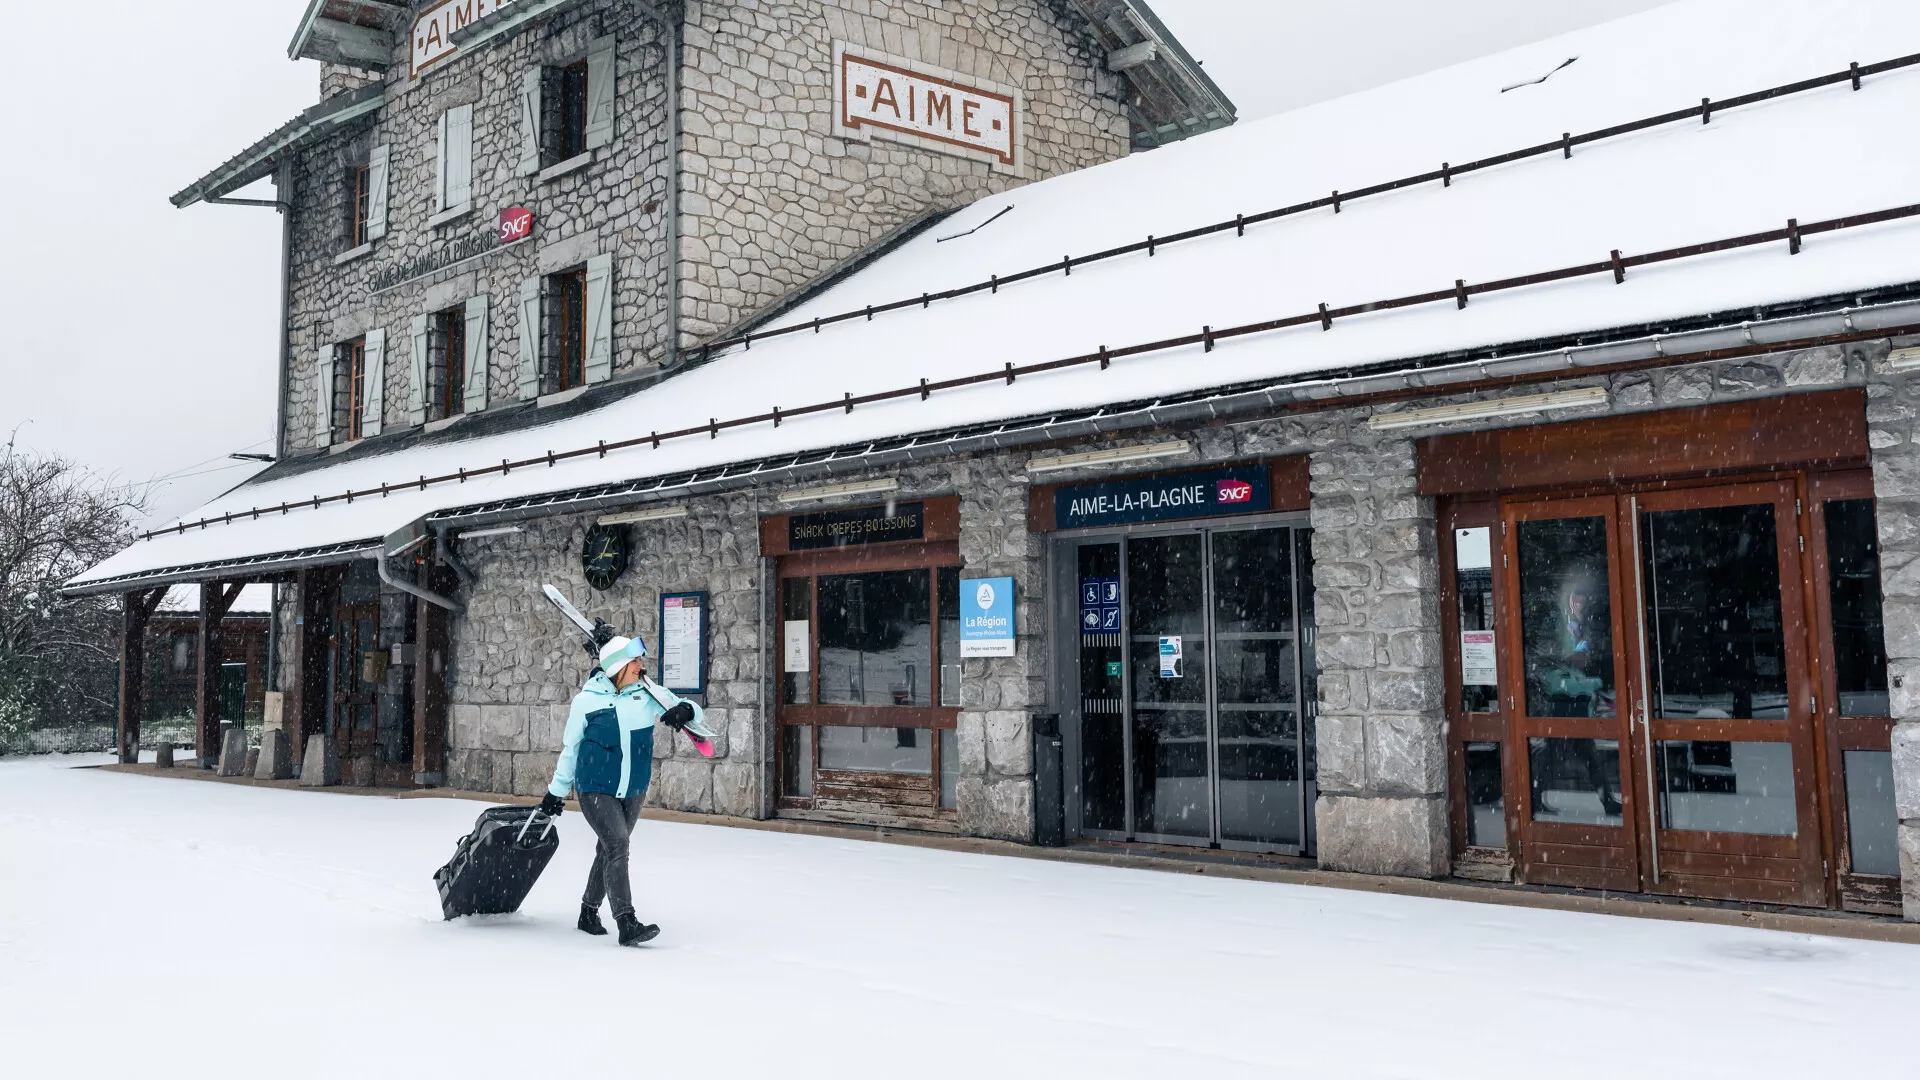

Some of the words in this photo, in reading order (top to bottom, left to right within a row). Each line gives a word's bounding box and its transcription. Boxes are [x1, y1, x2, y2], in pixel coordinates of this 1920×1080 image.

[871, 77, 981, 138] AIME
[501, 213, 530, 239] SNCF
[1070, 485, 1205, 516] AIME-LA-PLAGNE
[1218, 486, 1250, 501] SNCF
[794, 524, 824, 540] SNACK
[826, 520, 863, 536] CREPES
[865, 514, 917, 532] BOISSONS
[965, 616, 976, 627] La
[977, 615, 1007, 629] Région
